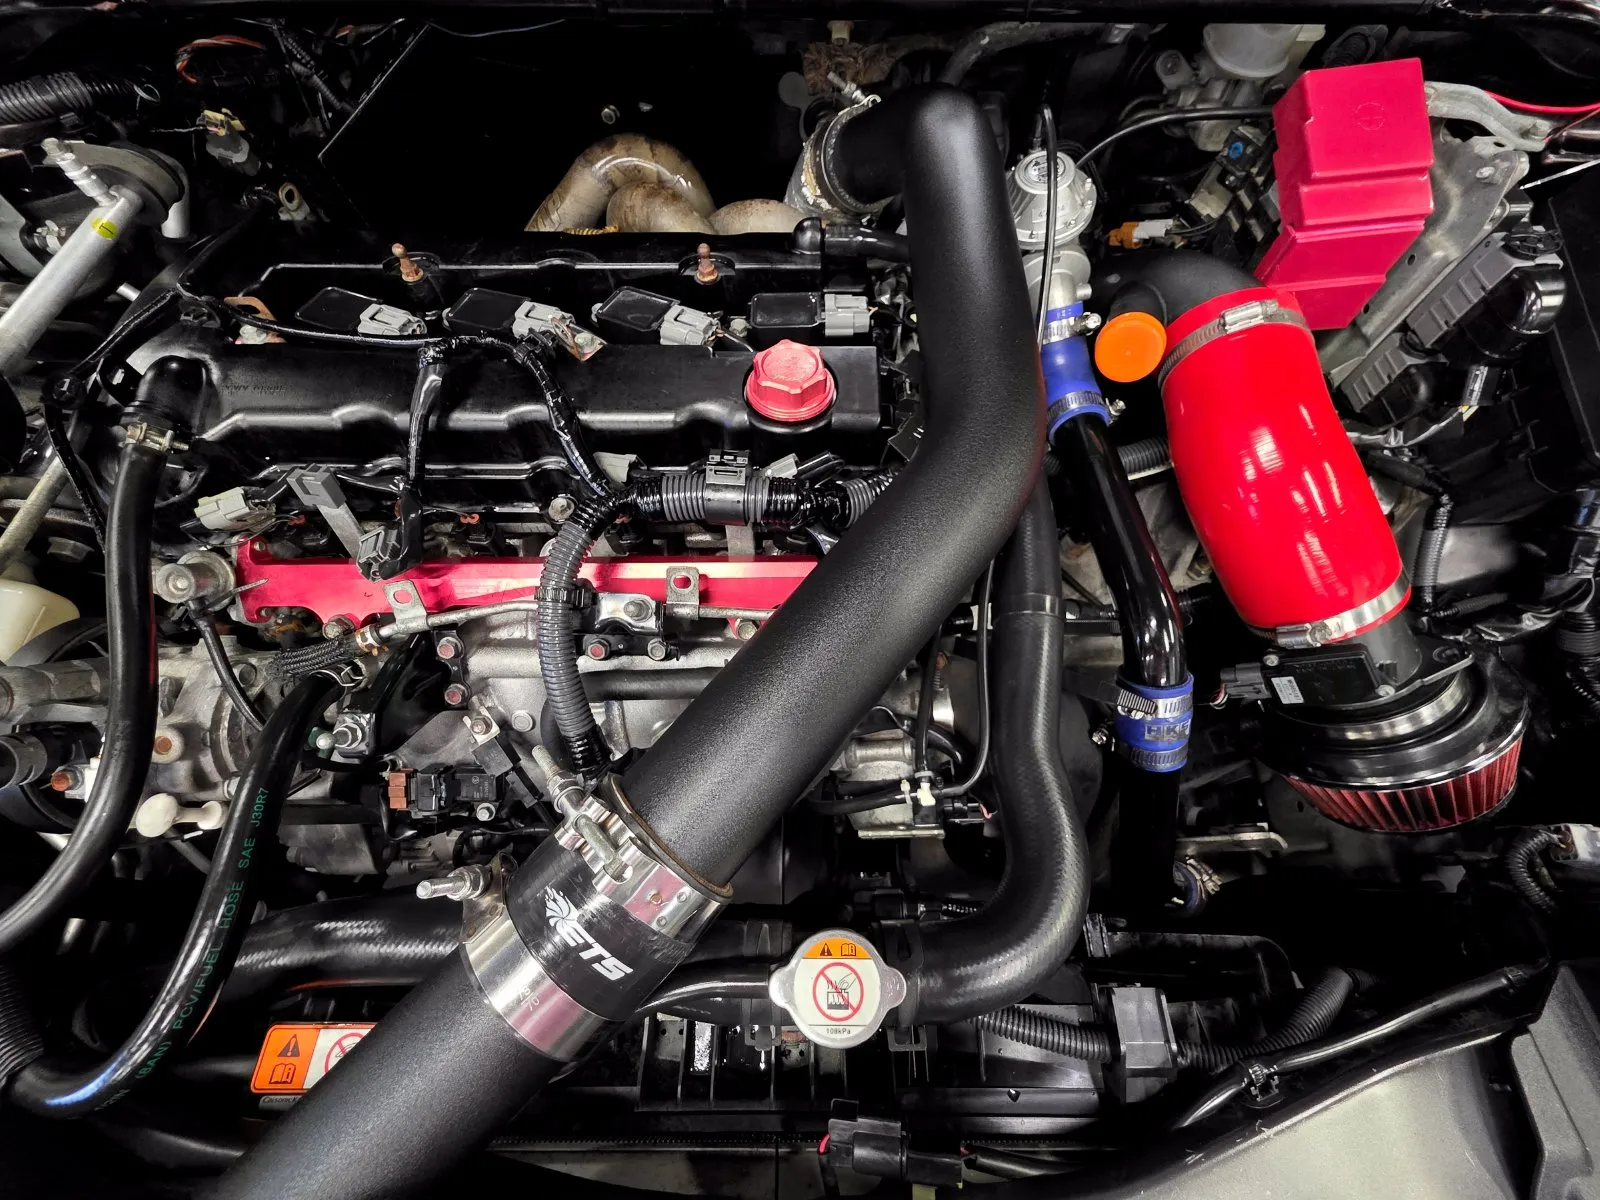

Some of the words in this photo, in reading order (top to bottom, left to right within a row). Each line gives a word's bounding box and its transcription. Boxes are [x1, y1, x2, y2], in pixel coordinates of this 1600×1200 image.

[172, 942, 224, 1030] PCV/FUEL
[218, 880, 245, 929] HOSE
[238, 838, 256, 869] SAE
[250, 787, 269, 827] J30R7
[556, 911, 634, 981] ETS
